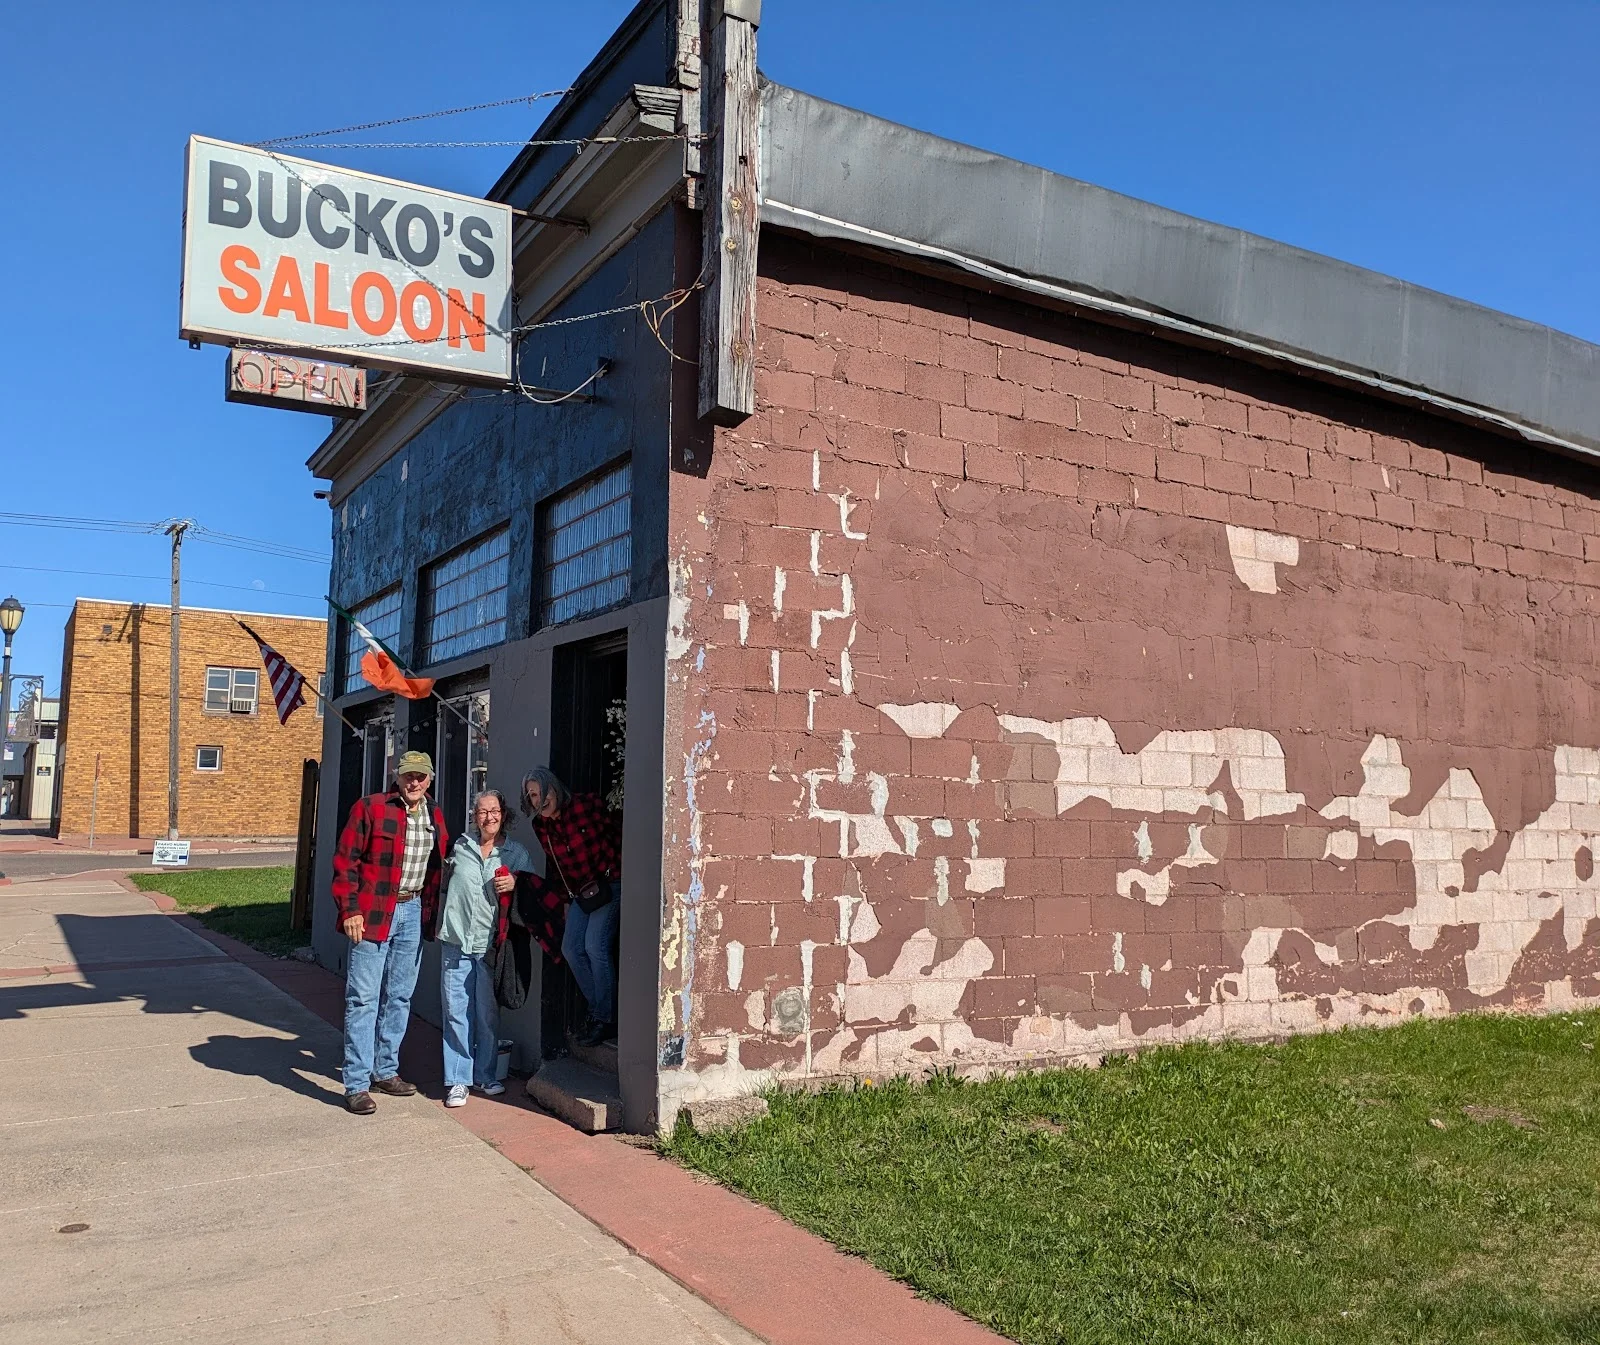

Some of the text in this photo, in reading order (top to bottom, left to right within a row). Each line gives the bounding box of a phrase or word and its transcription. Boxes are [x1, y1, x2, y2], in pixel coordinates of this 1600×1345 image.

[208, 159, 495, 279] BUCKO'S
[218, 244, 486, 353] SALOON
[239, 350, 363, 404] OPEN
